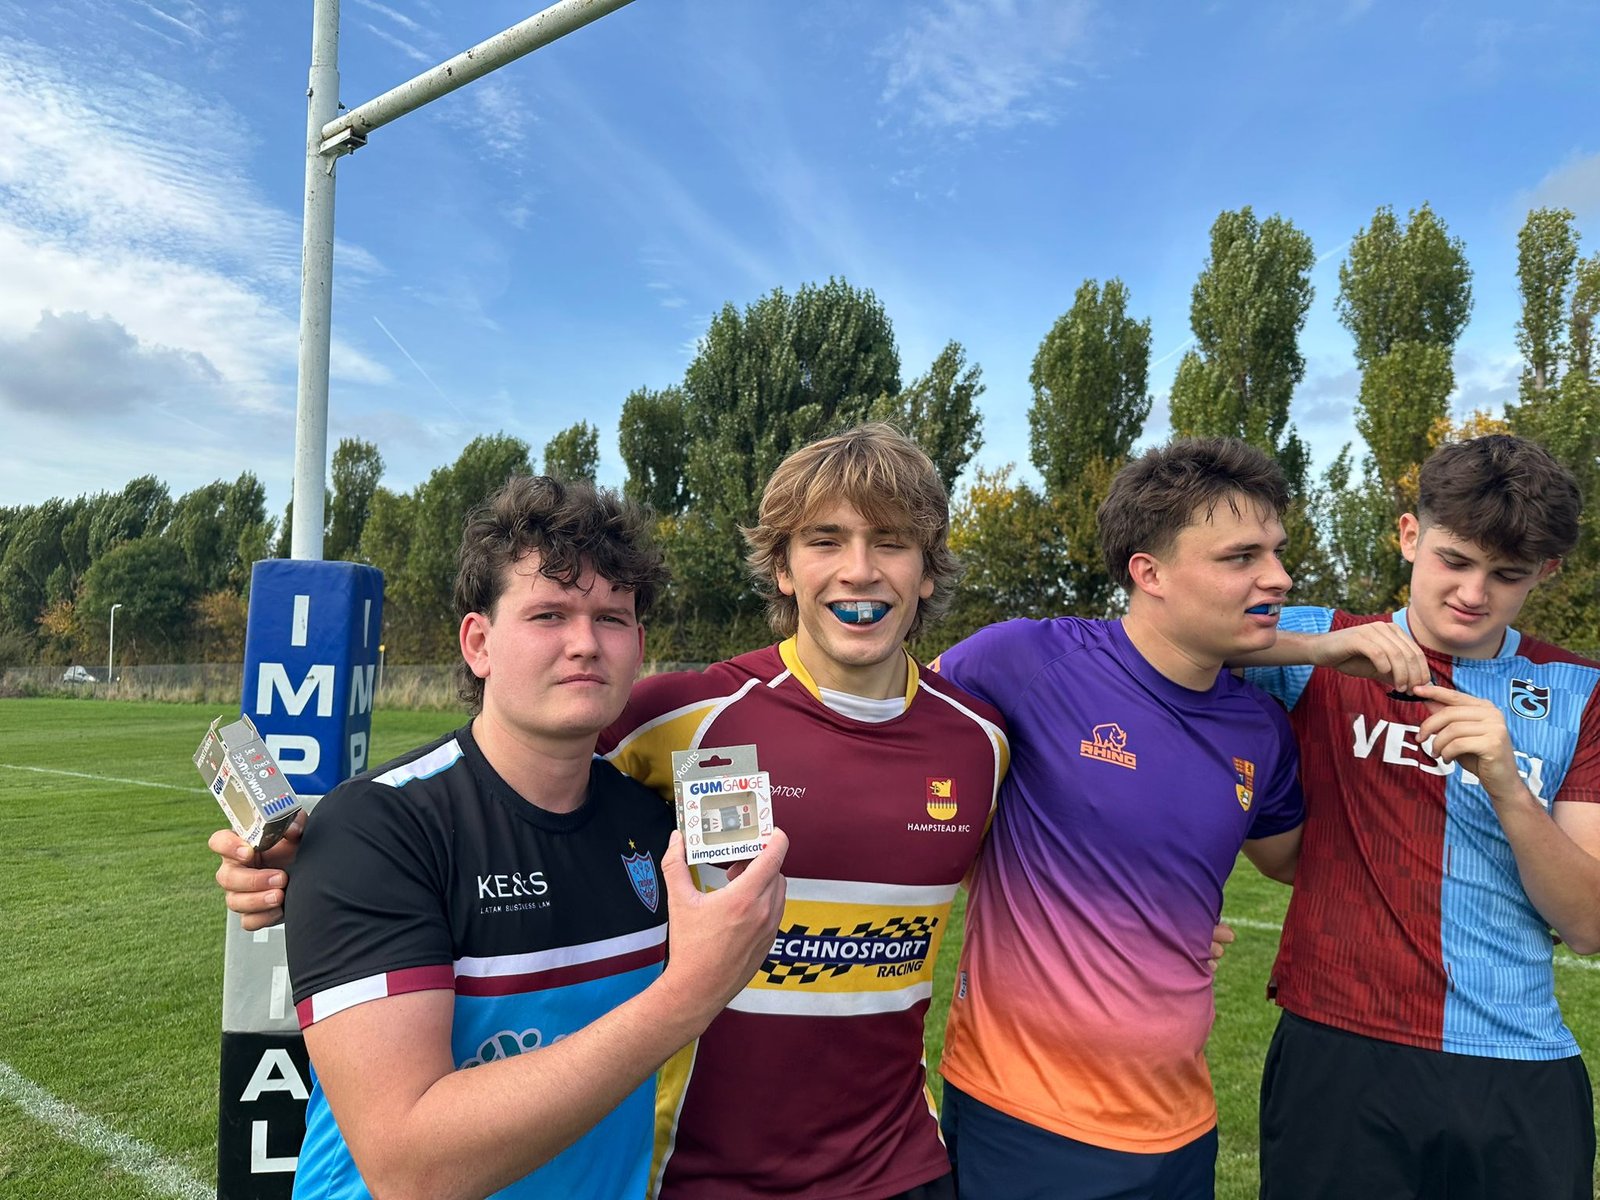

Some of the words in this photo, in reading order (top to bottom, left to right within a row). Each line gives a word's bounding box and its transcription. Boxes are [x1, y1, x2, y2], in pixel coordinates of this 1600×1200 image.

[676, 751, 700, 779] Adults
[1080, 743, 1136, 768] RHINO
[689, 776, 763, 796] GUMGAUGE
[770, 785, 806, 799] DATOR!
[907, 823, 957, 833] HAMPSTEAD
[958, 824, 970, 833] RFC
[477, 871, 549, 899] KE&S
[768, 938, 927, 959] ECHNOSPORT
[876, 960, 924, 978] RACING
